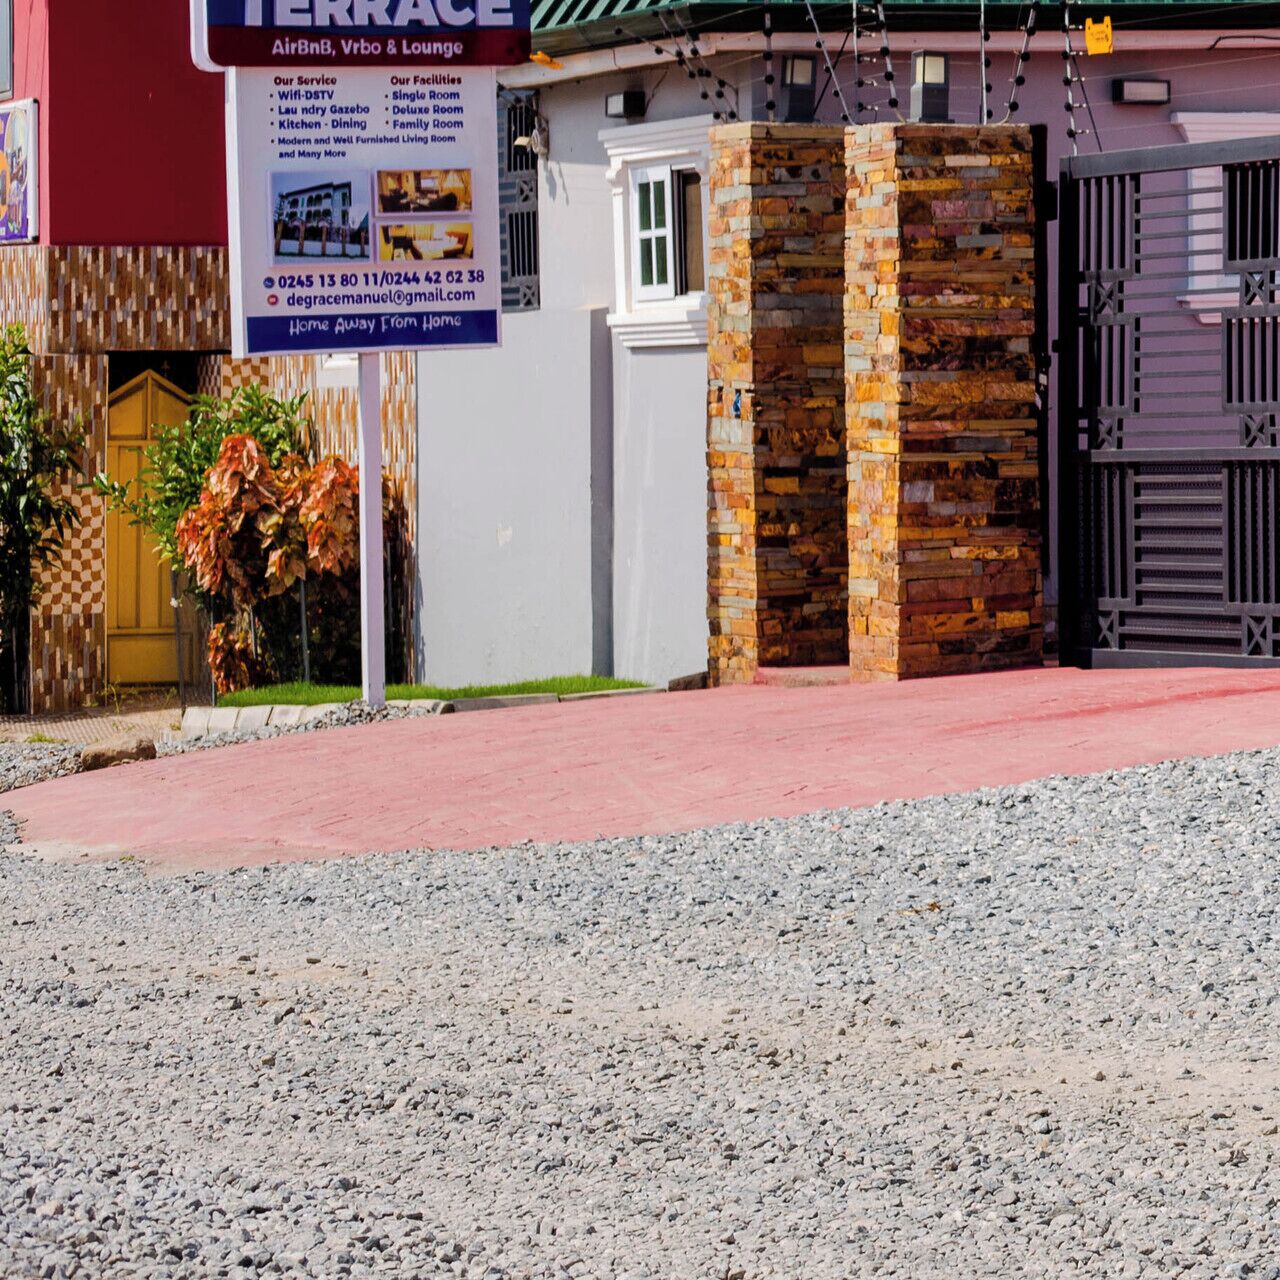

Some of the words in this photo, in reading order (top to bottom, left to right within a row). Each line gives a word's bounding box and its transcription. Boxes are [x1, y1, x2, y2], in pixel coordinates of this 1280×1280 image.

[271, 37, 336, 56] AirBnB,
[340, 38, 382, 55] Vrbo
[386, 39, 397, 55] &
[402, 39, 464, 58] Lounge
[274, 76, 294, 86] Our
[297, 74, 337, 86] Service
[390, 75, 410, 86] Our
[413, 73, 462, 85] Facilities
[392, 89, 426, 102] Single
[429, 90, 460, 100] Room
[330, 104, 370, 114] Gazebo
[392, 104, 430, 115] Deluxe
[432, 105, 464, 114] Room
[278, 118, 322, 129] Kitchen
[331, 117, 367, 131] Dining
[393, 118, 430, 131] Family
[432, 119, 464, 129] Room
[278, 136, 311, 145] Modern
[314, 136, 330, 145] and
[333, 135, 354, 144] Well
[356, 134, 400, 144] Furnished
[402, 134, 428, 145] Living
[431, 134, 456, 143] Room
[279, 150, 295, 158] and
[298, 150, 322, 160] Many
[324, 149, 346, 158] More
[278, 274, 314, 288] 0245
[319, 273, 336, 288] 13
[340, 273, 358, 287] 80
[424, 270, 442, 285] 42
[467, 269, 485, 283] 38
[286, 287, 475, 309] degracemanuel@gmail.com
[289, 318, 329, 336] Home
[334, 317, 376, 335] Away
[381, 314, 418, 333] From
[422, 314, 462, 331] Home
